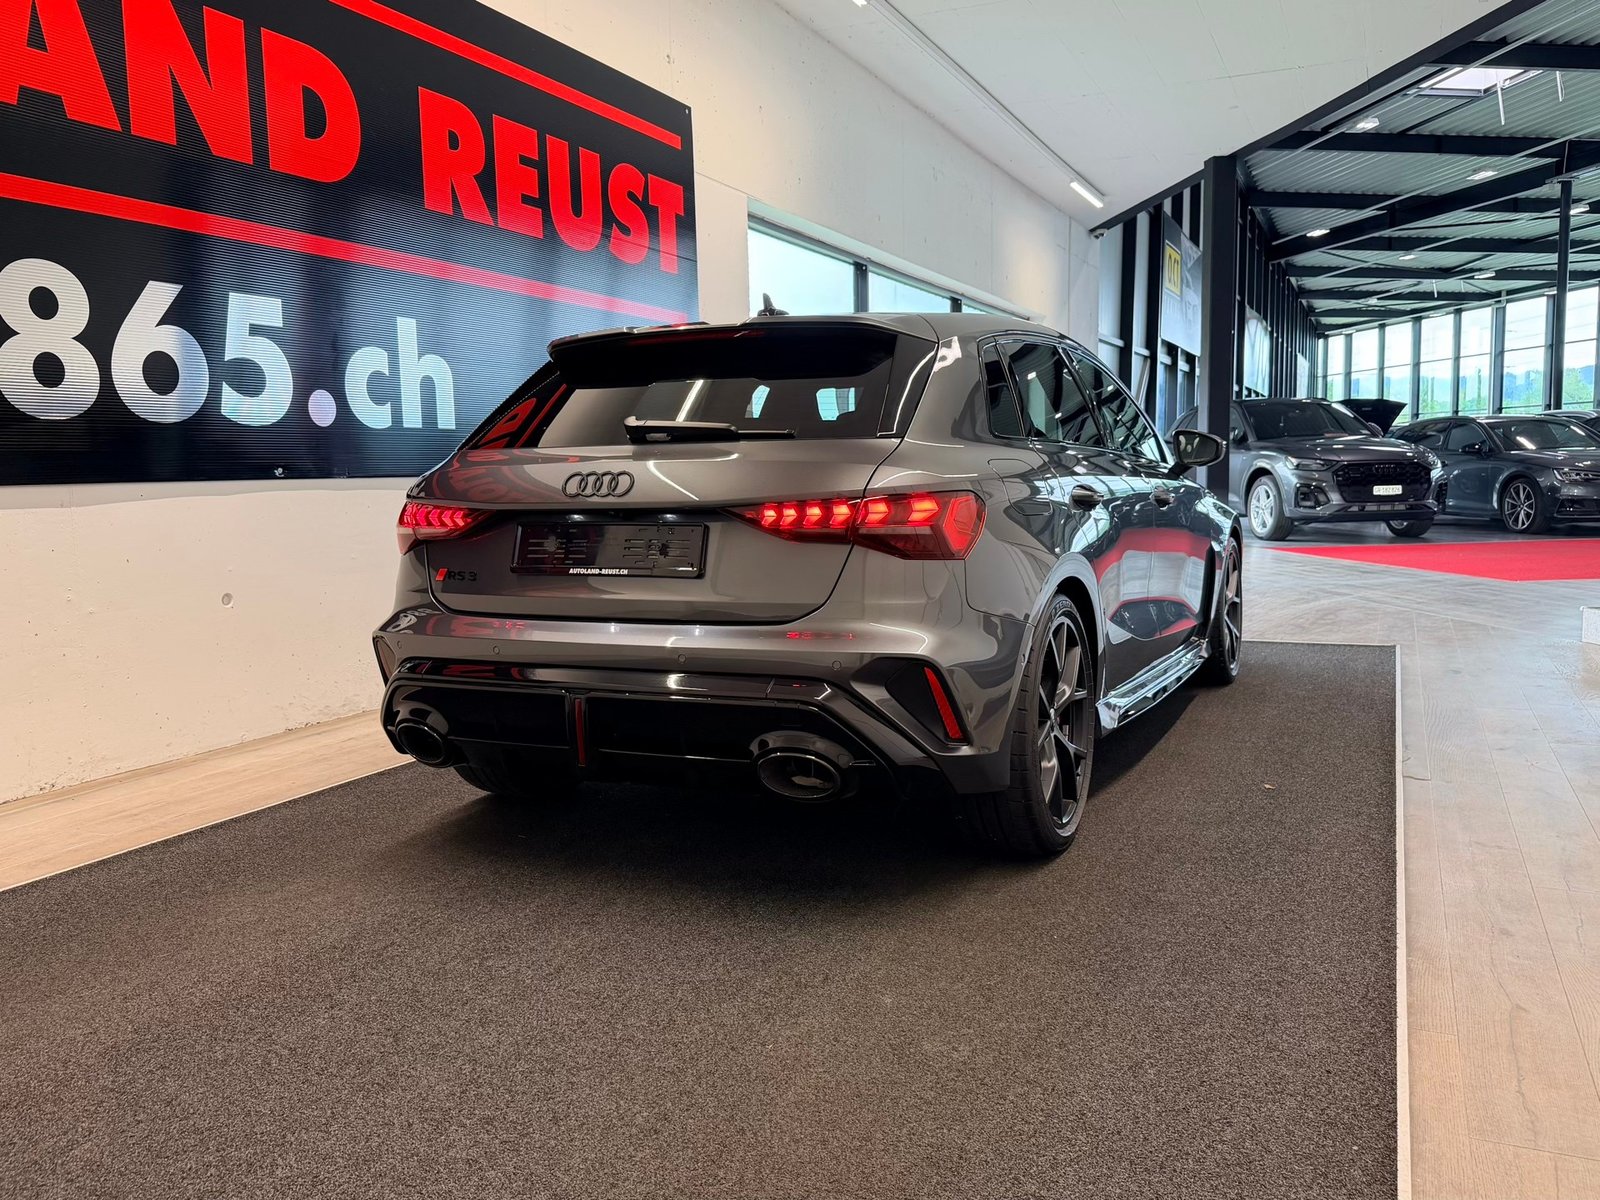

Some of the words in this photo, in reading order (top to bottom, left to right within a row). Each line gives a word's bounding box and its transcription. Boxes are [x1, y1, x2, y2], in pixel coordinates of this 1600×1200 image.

[0, 0, 361, 183] AND
[419, 87, 684, 273] REUST
[0, 258, 456, 430] 865.ch
[447, 570, 466, 581] RS
[467, 570, 478, 582] 3
[568, 567, 629, 576] AUTOLAND-REUST.CH
